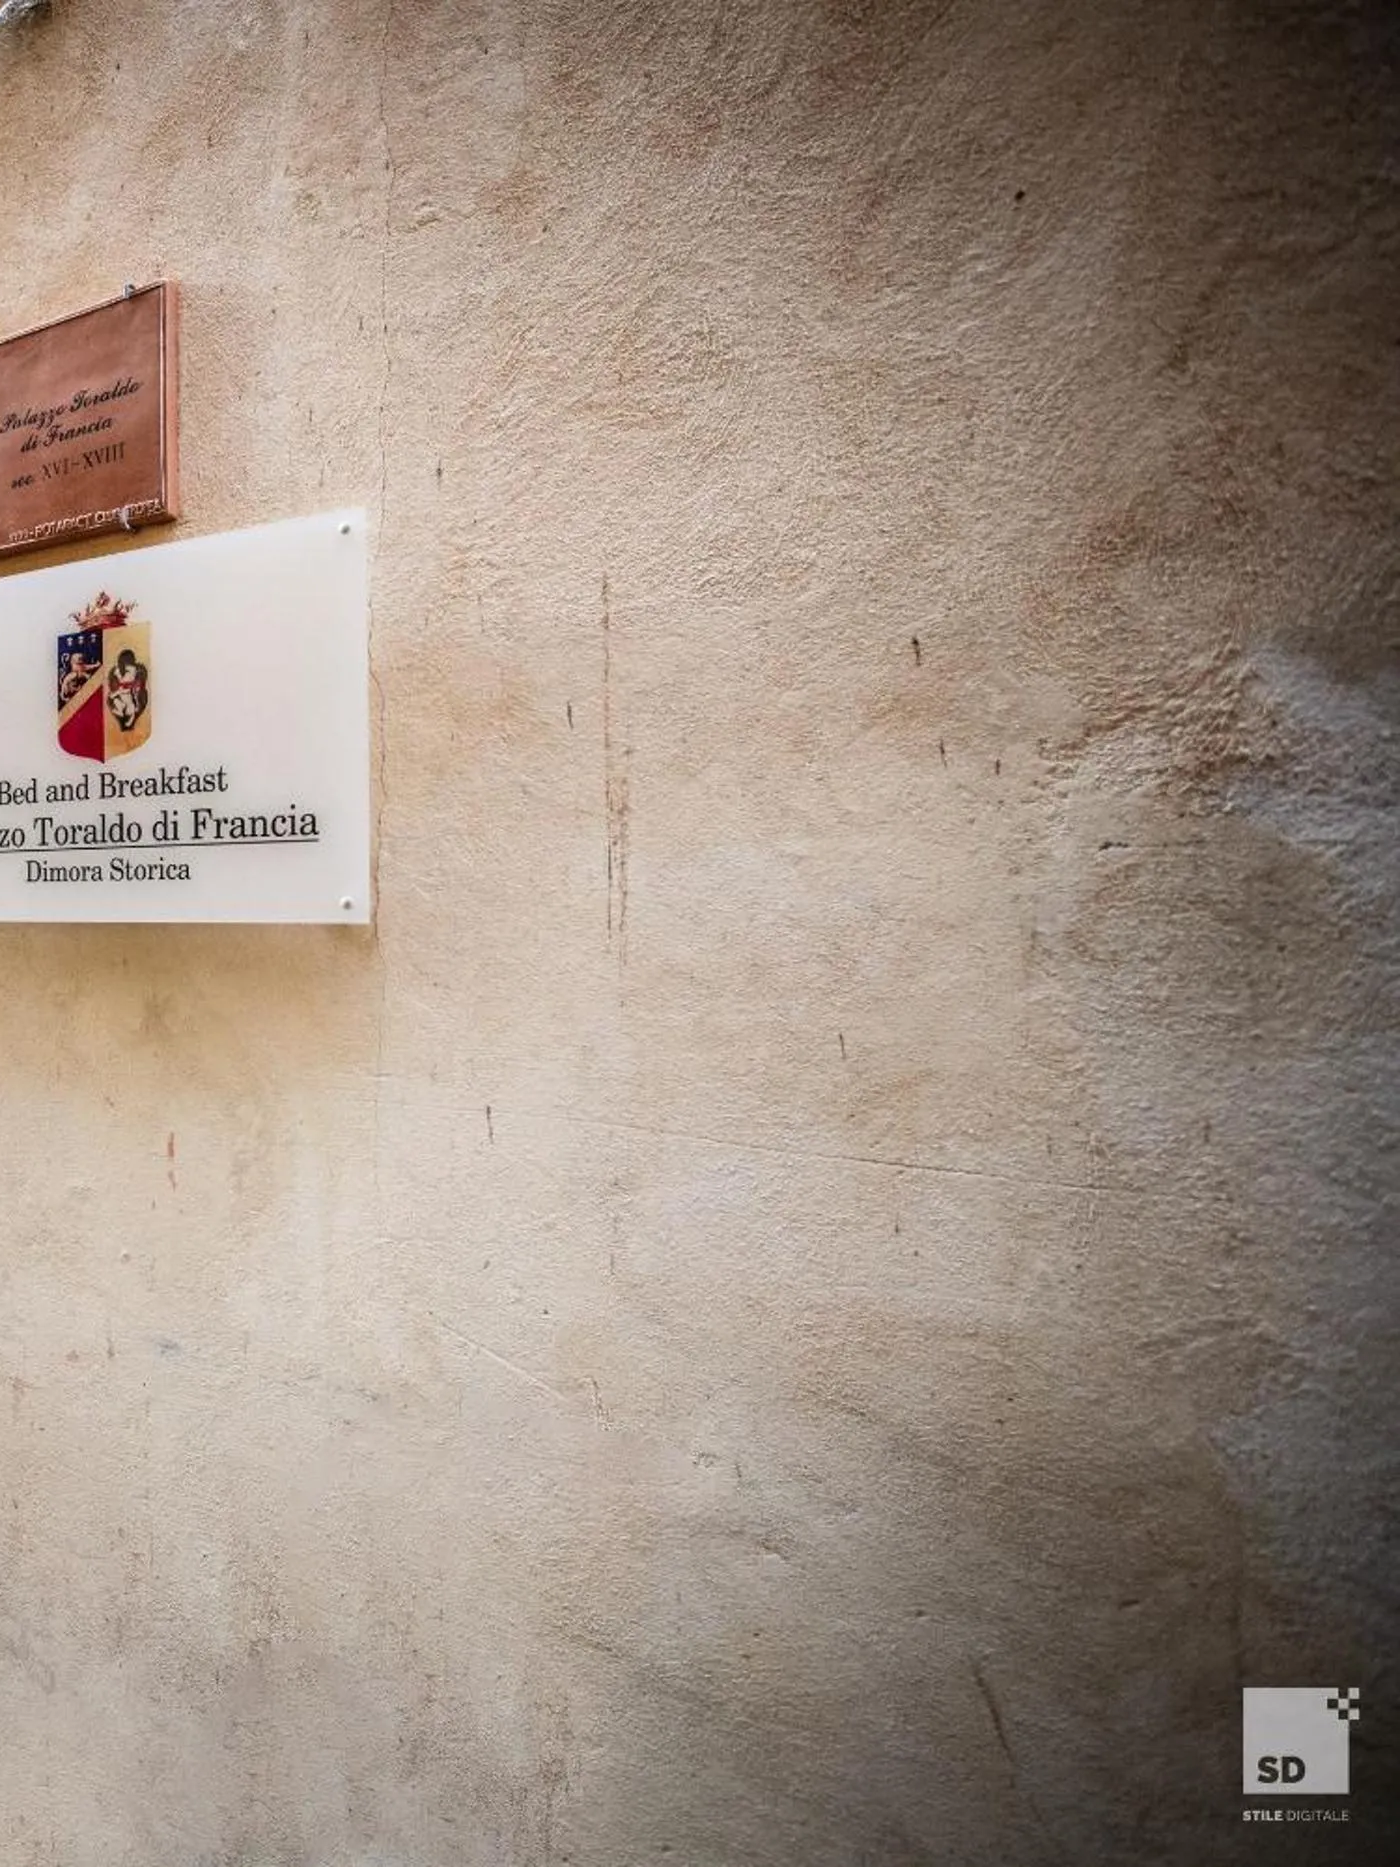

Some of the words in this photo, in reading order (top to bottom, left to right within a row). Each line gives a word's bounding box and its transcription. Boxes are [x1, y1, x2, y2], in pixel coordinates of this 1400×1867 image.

[0, 405, 67, 434] Palazzo
[69, 377, 143, 413] Toraldo
[20, 433, 41, 453] di
[42, 416, 114, 447] Francia
[46, 774, 90, 802] and
[99, 766, 229, 800] Breakfast
[33, 813, 142, 846] Toraldo
[152, 809, 180, 842] di
[191, 803, 319, 840] Francia
[26, 860, 103, 883] Dimora
[109, 857, 191, 882] Storica
